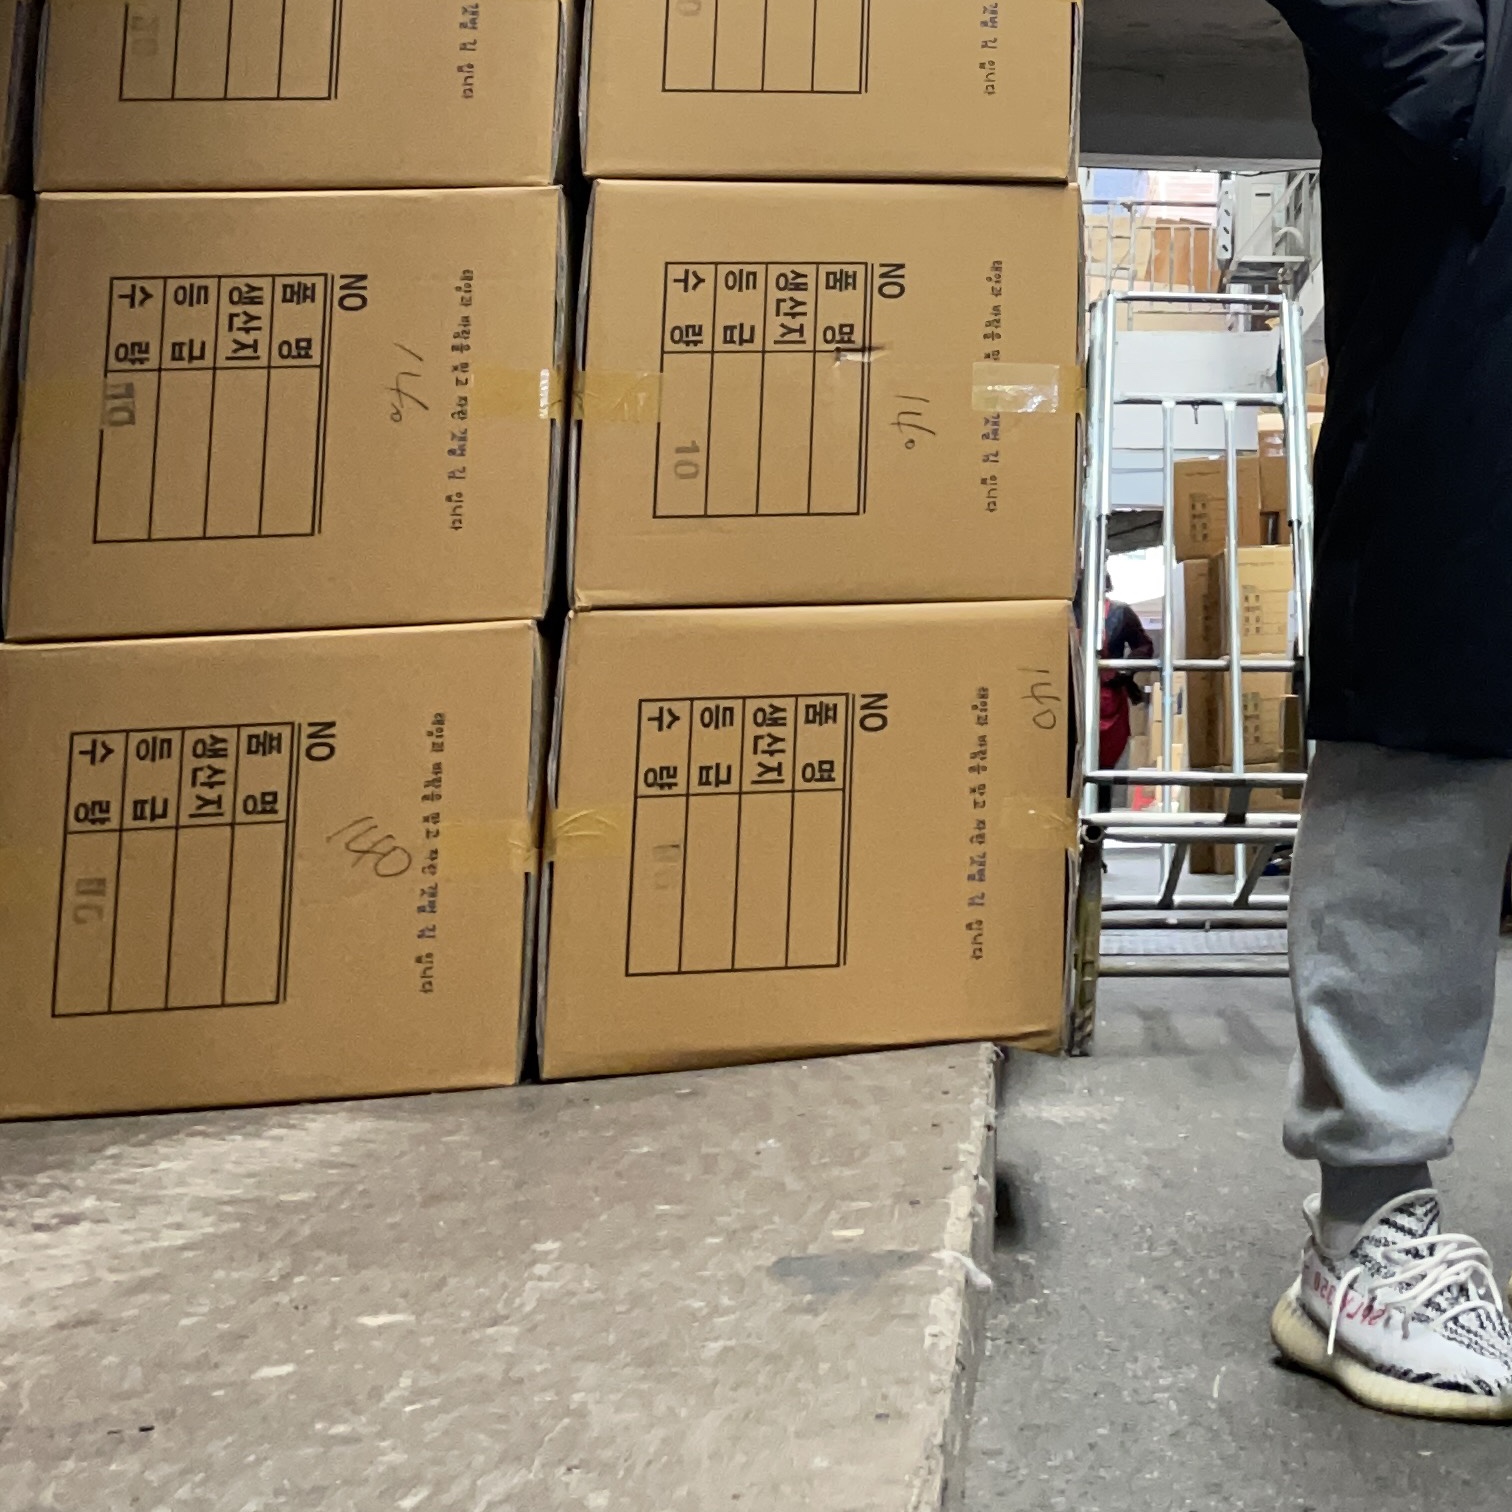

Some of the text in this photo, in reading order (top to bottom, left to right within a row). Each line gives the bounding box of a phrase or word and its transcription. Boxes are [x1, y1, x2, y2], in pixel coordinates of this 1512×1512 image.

[337, 273, 369, 312] NO
[773, 269, 809, 345] 생산지
[877, 262, 906, 300] NO
[225, 282, 264, 361] 생산지
[858, 692, 889, 733] NO
[1032, 668, 1051, 729] 140
[304, 720, 337, 762] NO
[750, 703, 788, 785] 생산지
[188, 733, 229, 819] 생산지
